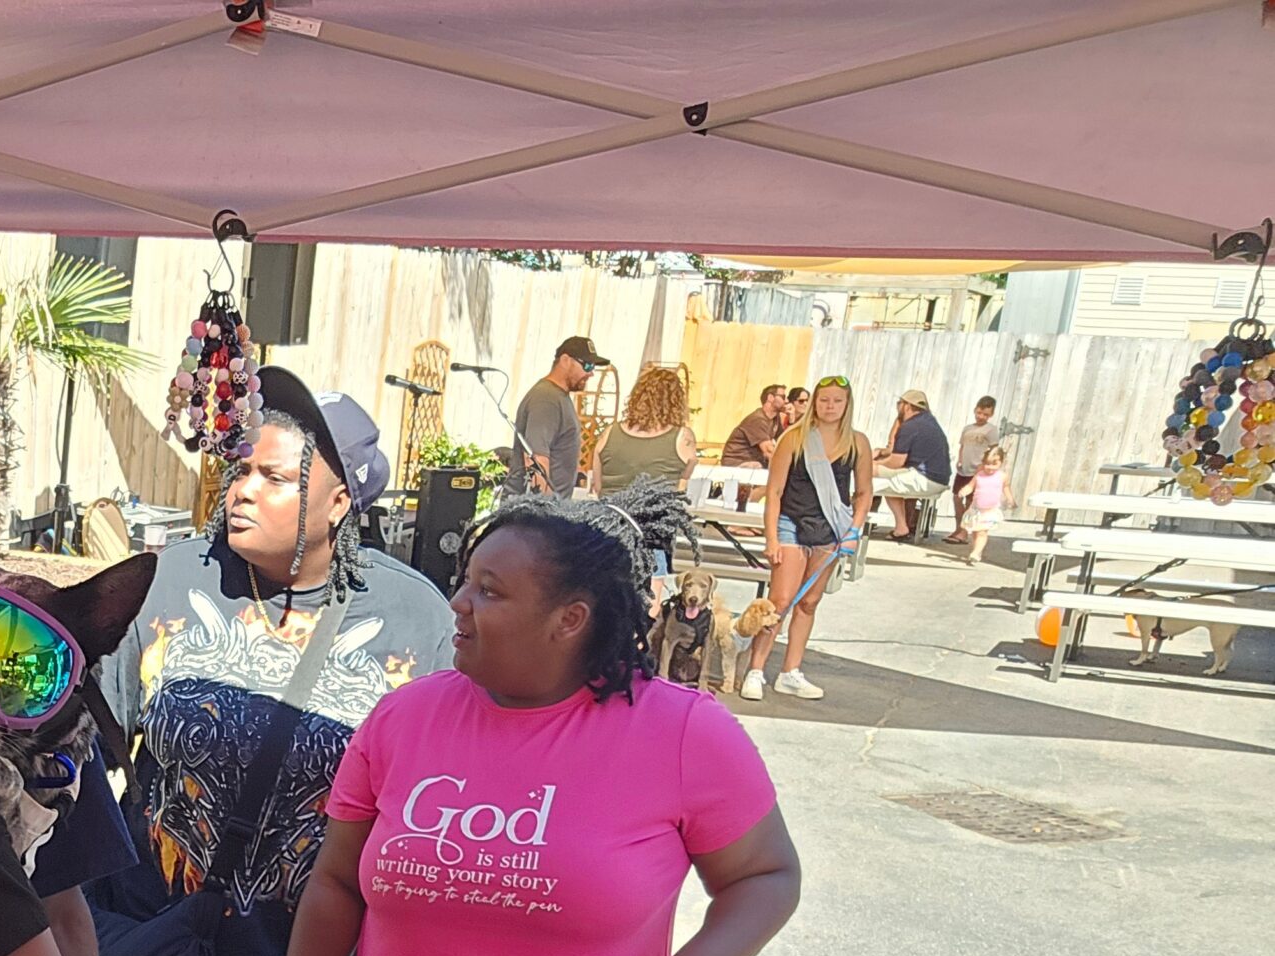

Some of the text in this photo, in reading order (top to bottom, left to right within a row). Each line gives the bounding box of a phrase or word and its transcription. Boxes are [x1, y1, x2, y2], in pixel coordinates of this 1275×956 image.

[381, 775, 556, 865] God
[376, 856, 559, 895] writing your story
[476, 848, 540, 871] is still
[371, 876, 392, 897] Stop
[443, 886, 460, 899] to
[463, 889, 502, 905] steal
[501, 892, 525, 908] the
[526, 900, 563, 915] pen
